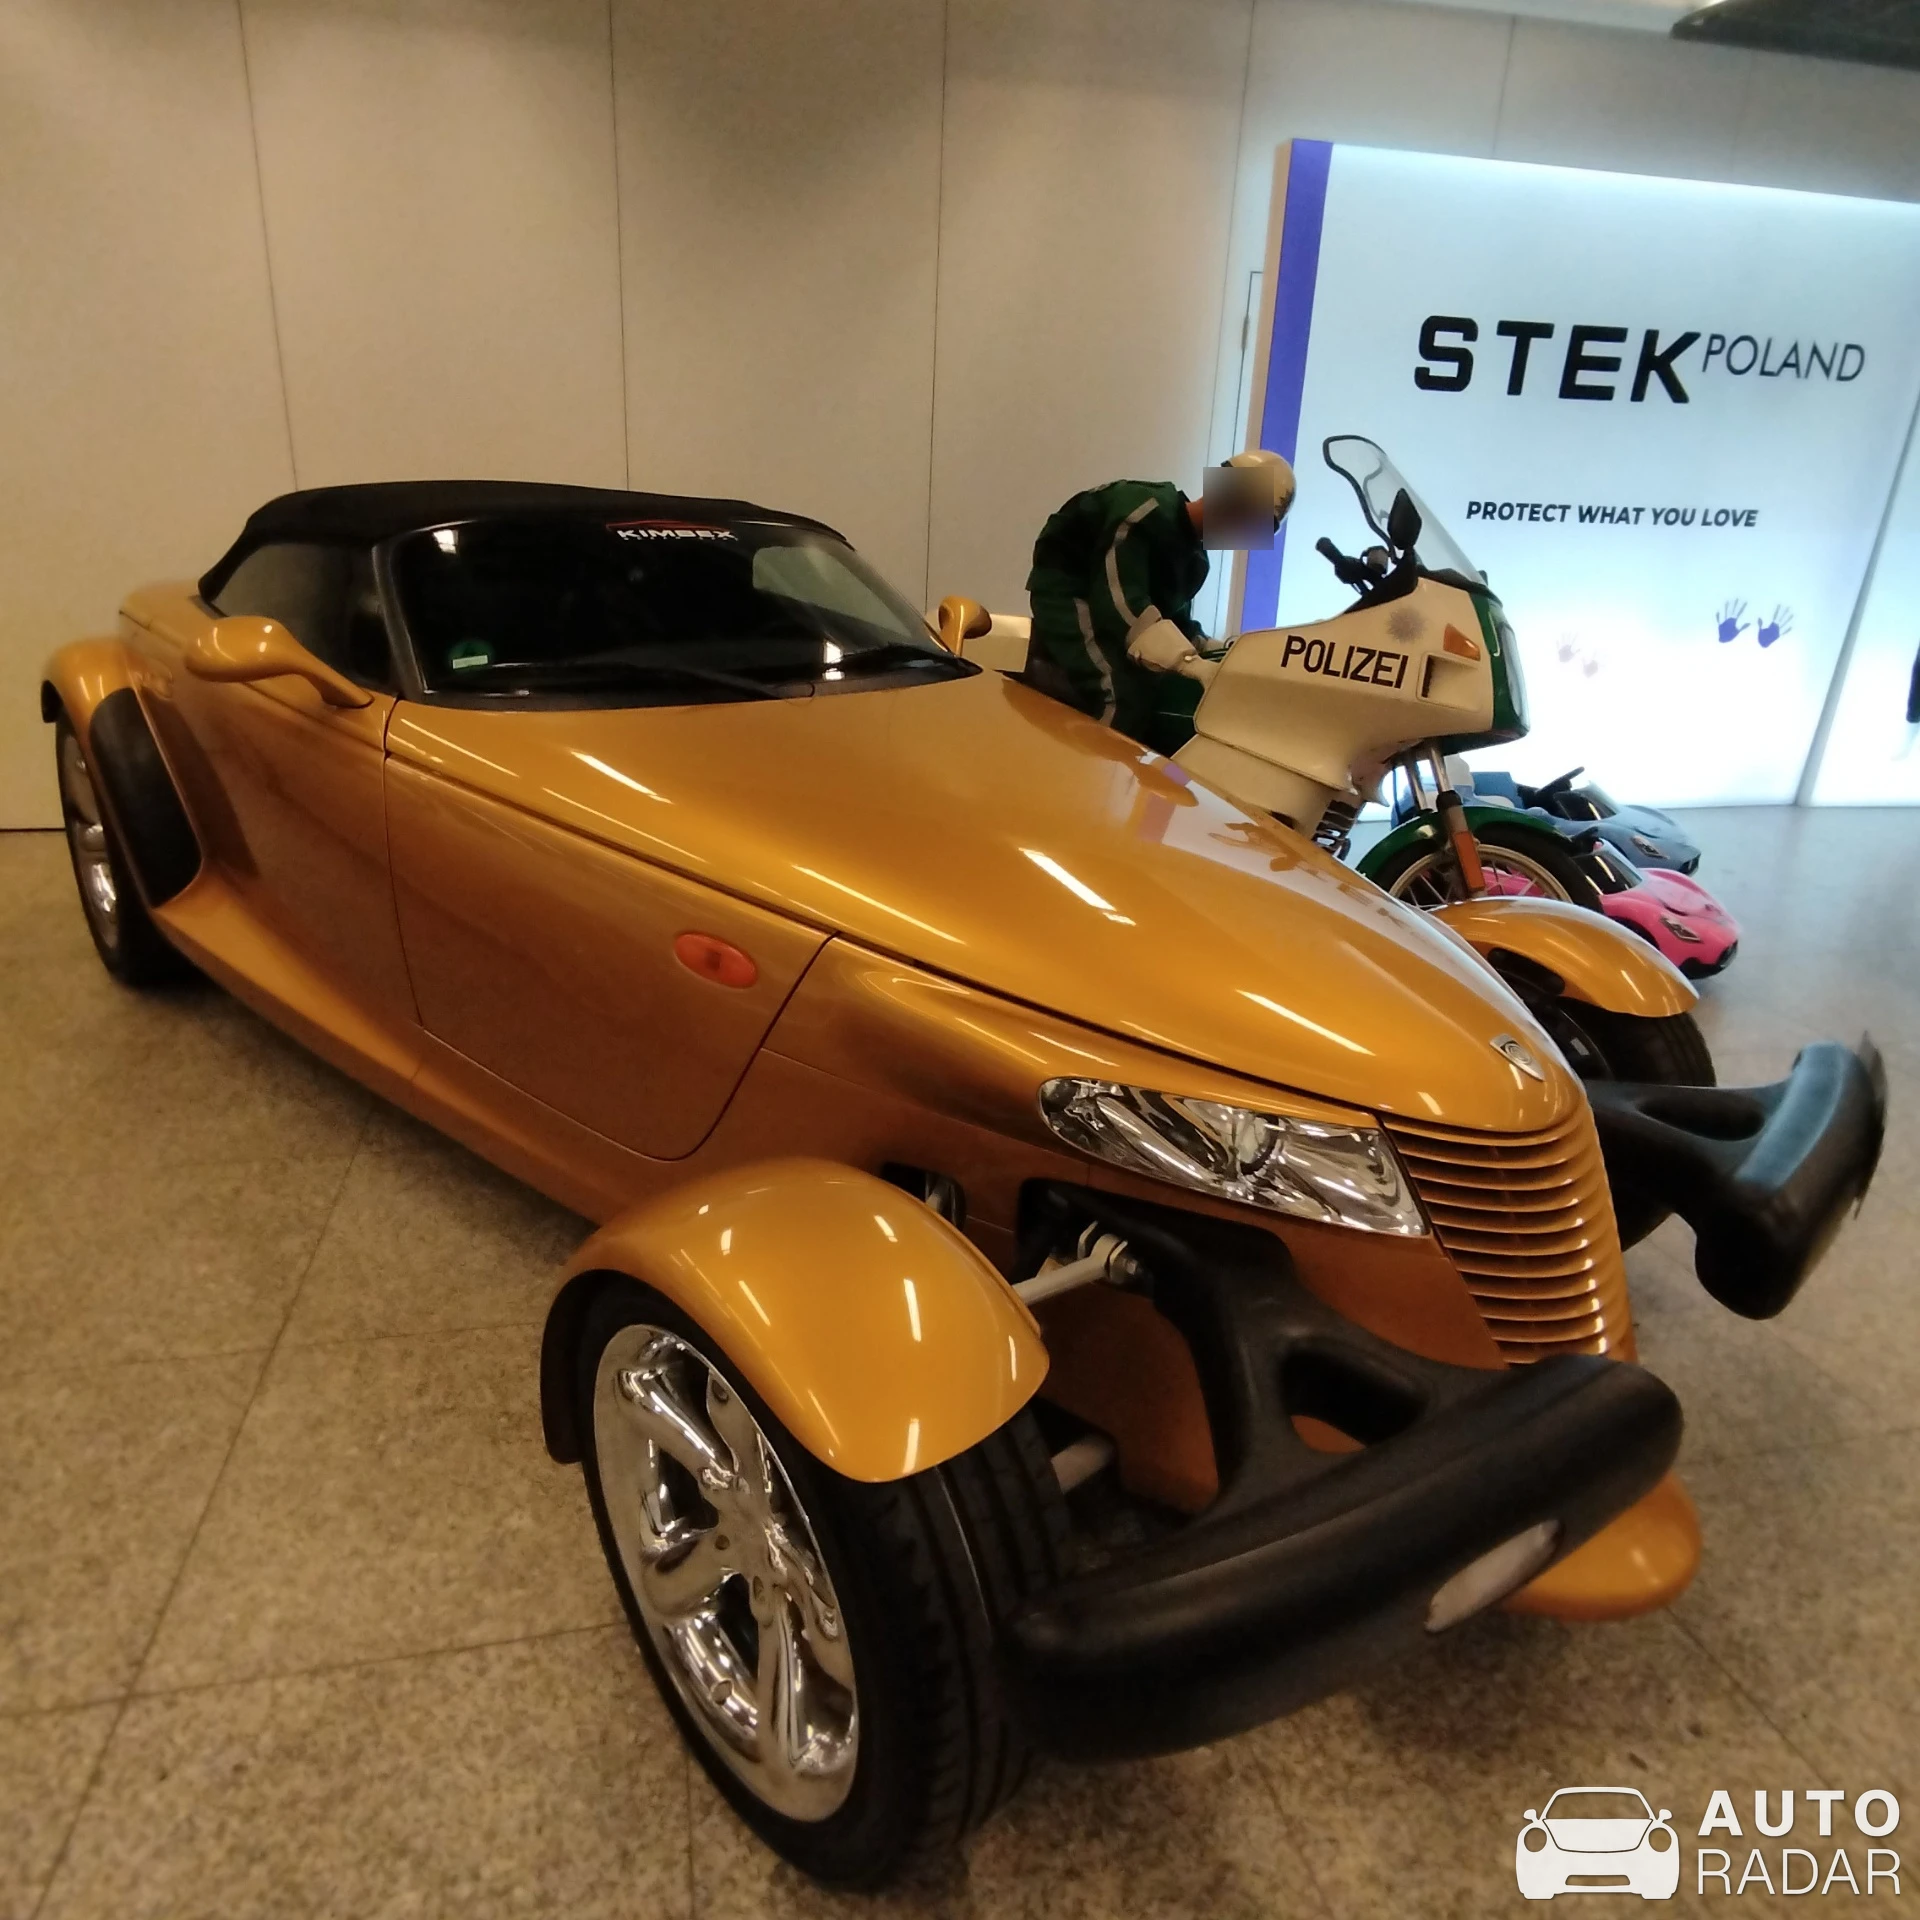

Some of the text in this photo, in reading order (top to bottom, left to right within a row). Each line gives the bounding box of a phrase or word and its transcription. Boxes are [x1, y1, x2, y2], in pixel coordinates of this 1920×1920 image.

[1414, 315, 1866, 404] STEK POLAND
[1466, 500, 1759, 528] PROTECT WHAT YOU LOVE
[1281, 635, 1409, 689] POLIZEI
